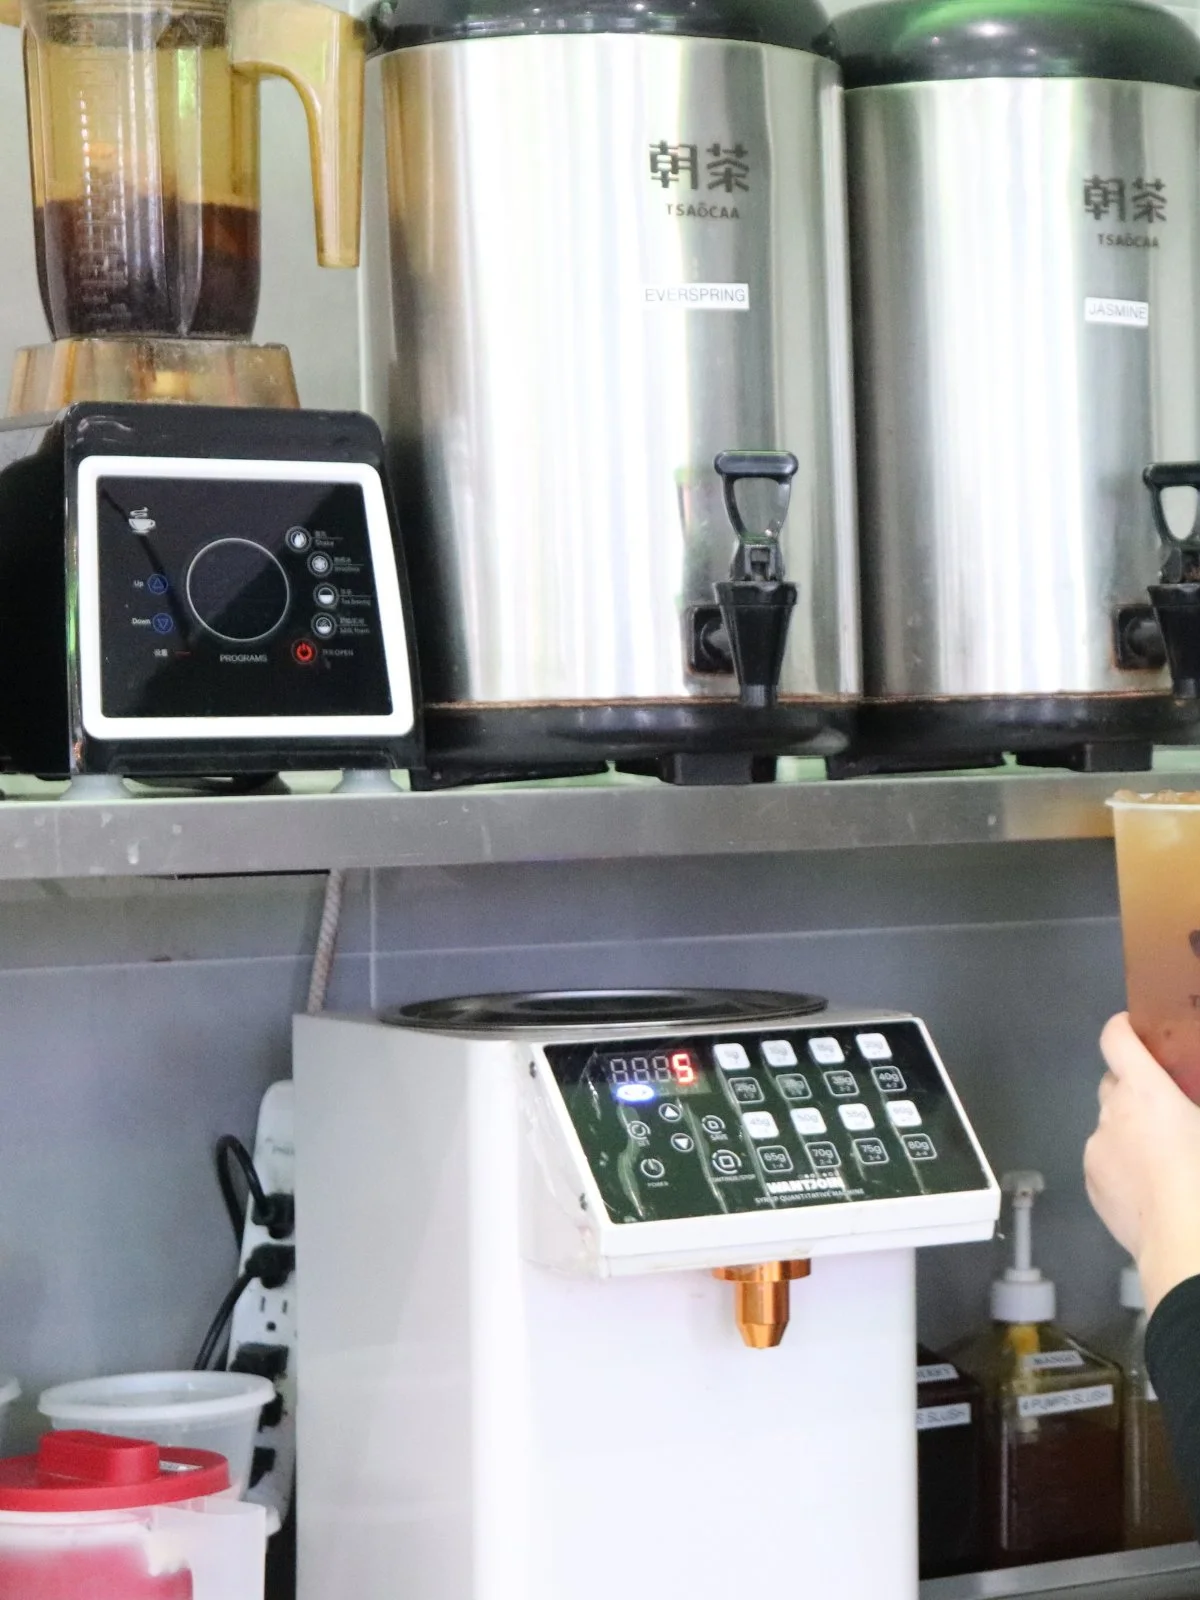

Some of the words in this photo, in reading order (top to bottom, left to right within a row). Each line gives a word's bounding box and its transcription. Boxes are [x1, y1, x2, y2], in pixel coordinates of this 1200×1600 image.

[649, 140, 750, 192] 朝茶
[1083, 174, 1168, 224] 朝茶
[644, 287, 746, 302] EVERSPRING
[1088, 303, 1147, 320] JASMINE
[134, 579, 144, 589] Up
[131, 617, 151, 625] Down
[219, 653, 268, 663] PROGRAMS
[672, 1053, 694, 1083] 5
[812, 1148, 833, 1159] 70g
[860, 1144, 882, 1155] 75g
[763, 1152, 787, 1163] 65g
